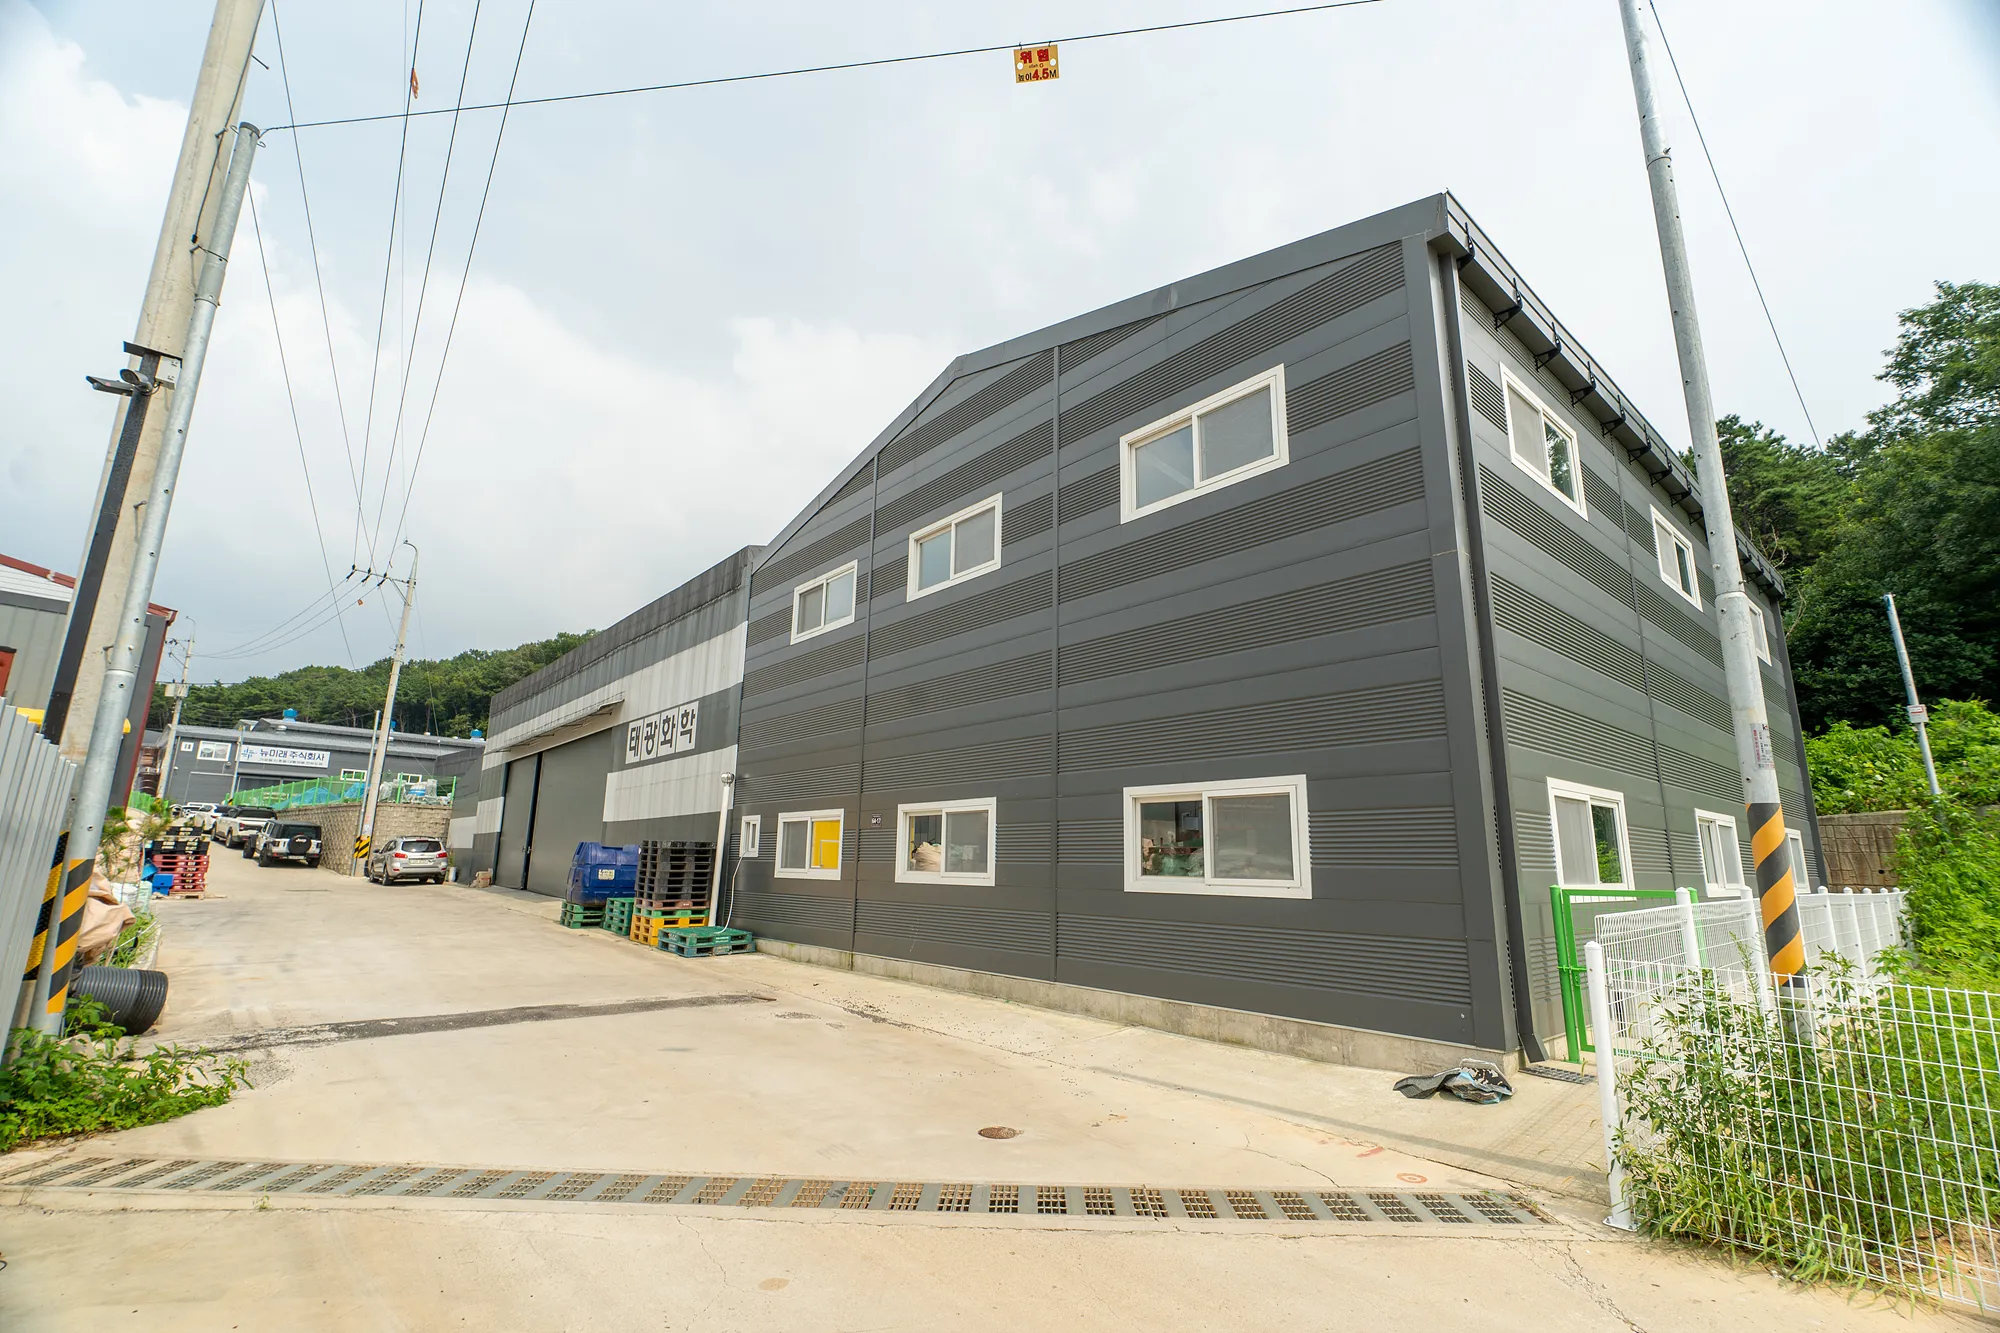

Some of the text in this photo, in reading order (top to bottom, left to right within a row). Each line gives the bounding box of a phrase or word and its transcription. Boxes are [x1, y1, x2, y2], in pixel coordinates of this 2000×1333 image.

[629, 709, 695, 757] 태광화학
[260, 748, 325, 761] 뉴미래 주식회사
